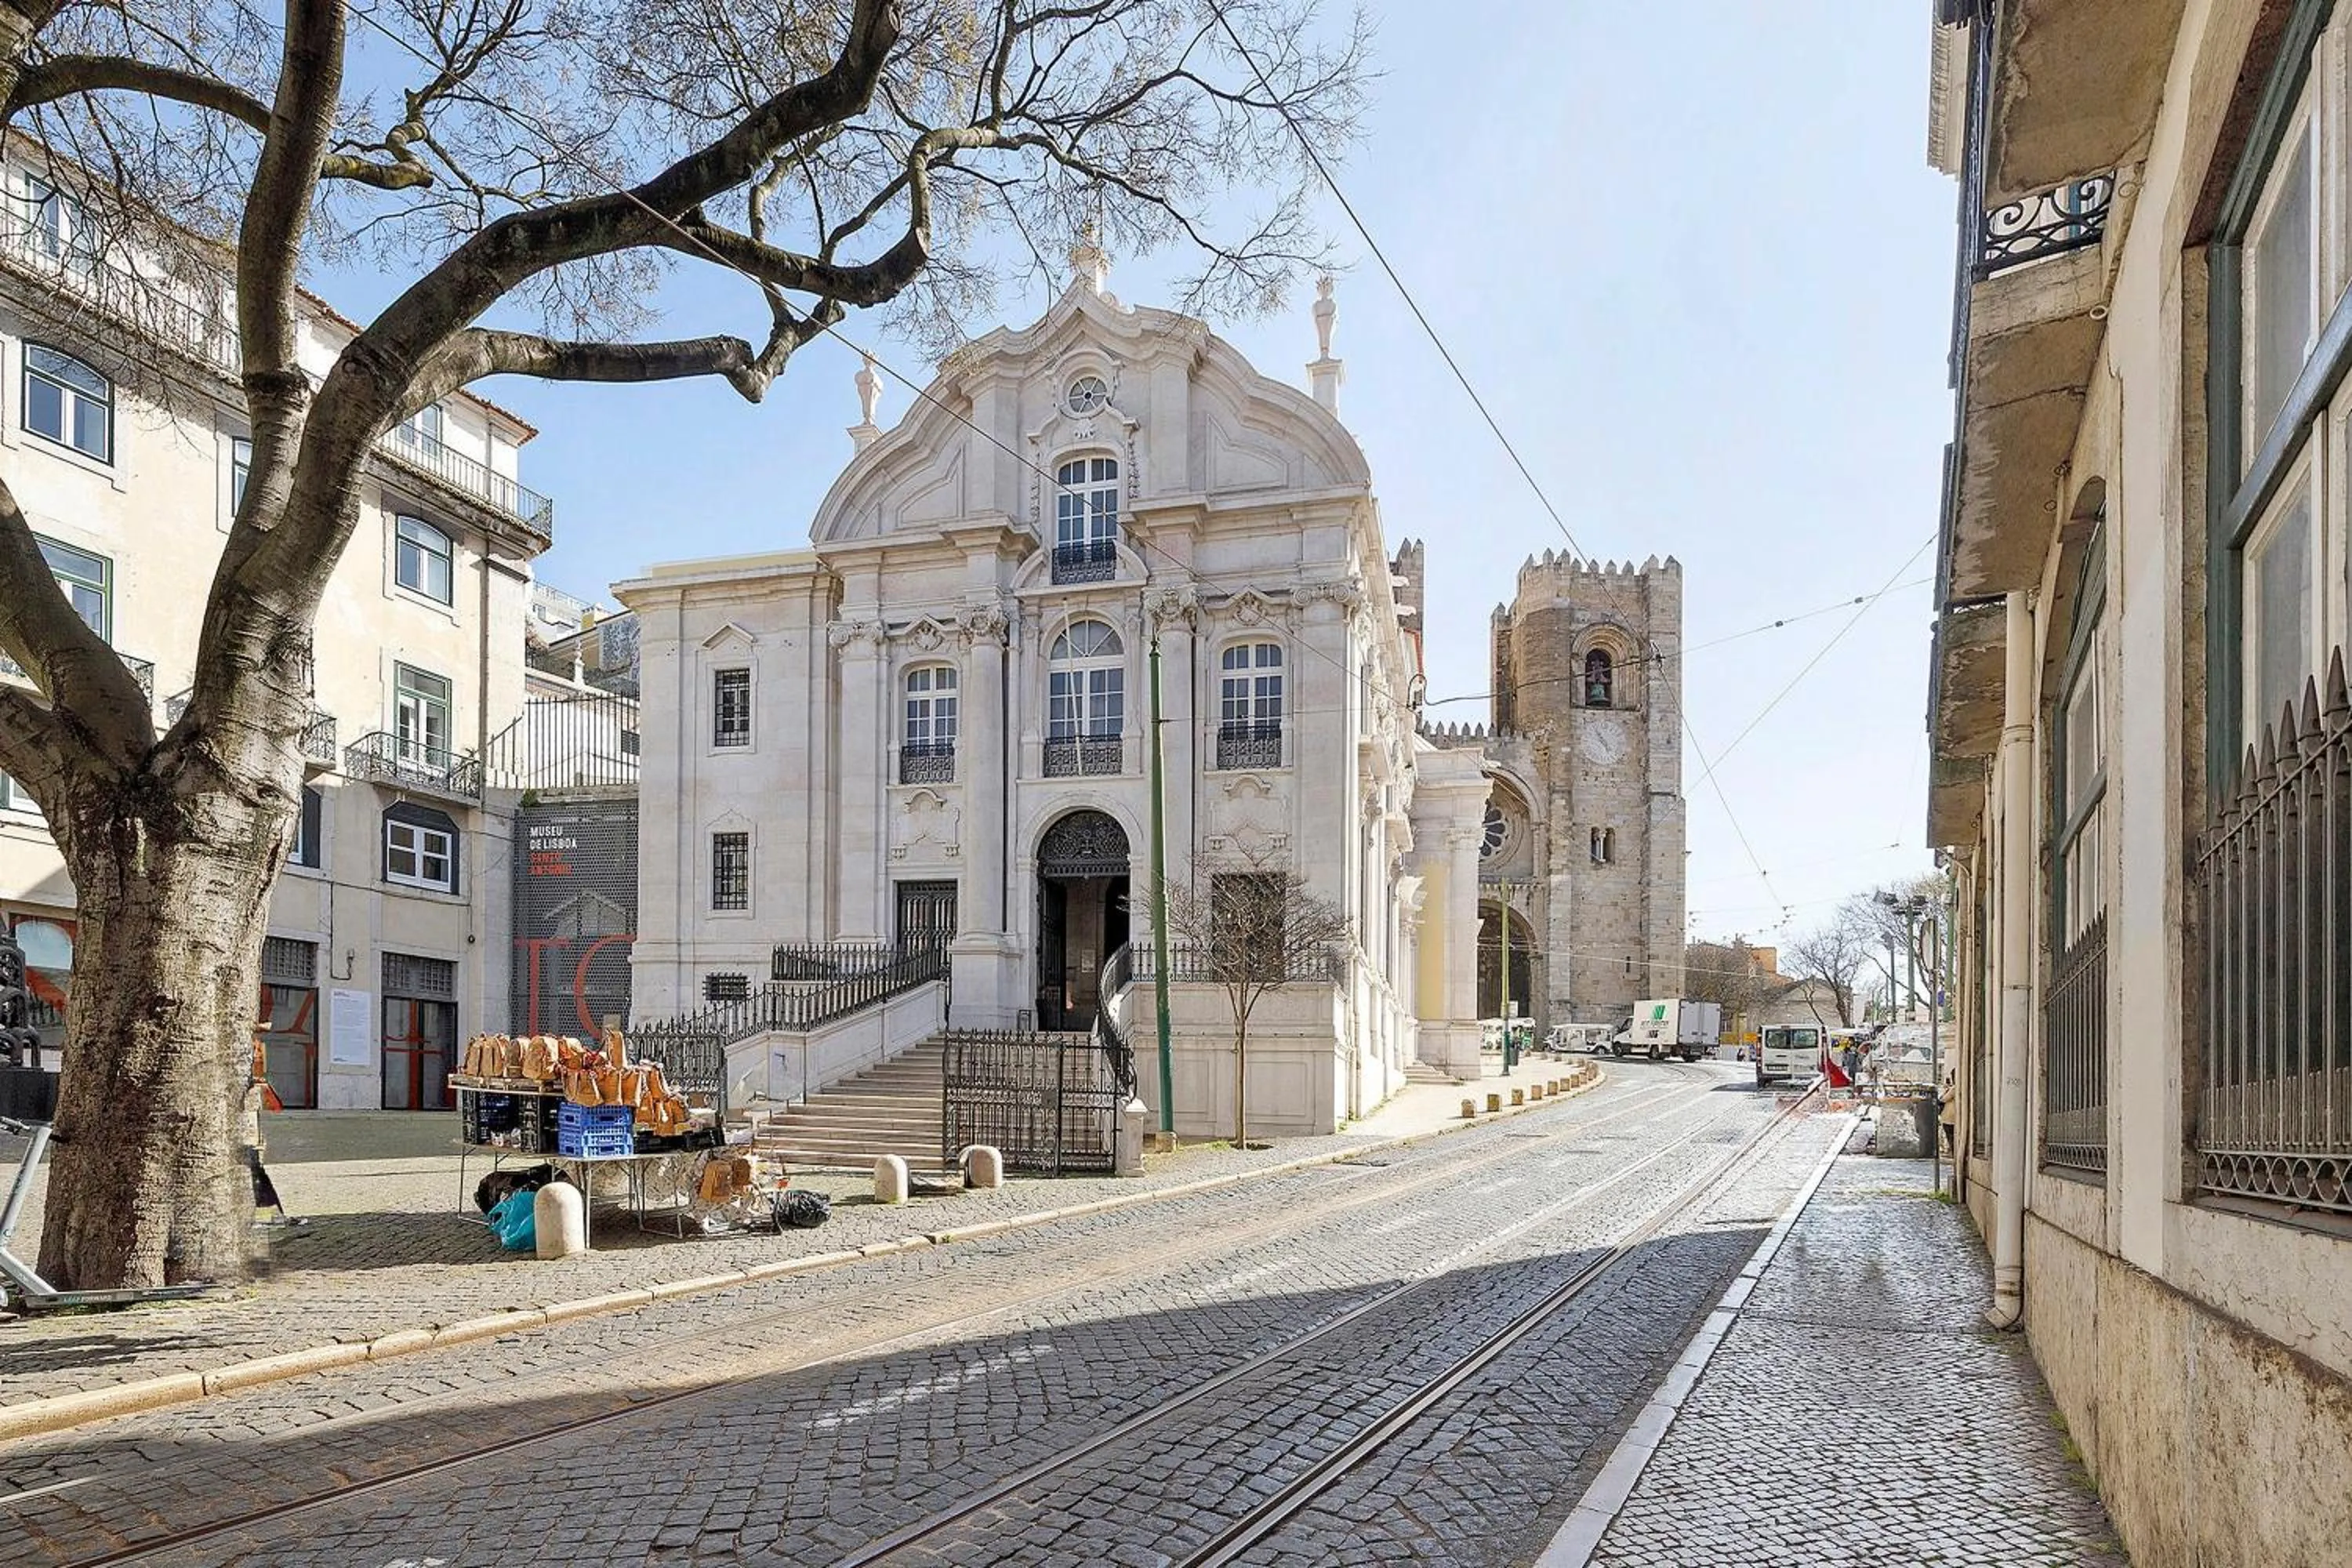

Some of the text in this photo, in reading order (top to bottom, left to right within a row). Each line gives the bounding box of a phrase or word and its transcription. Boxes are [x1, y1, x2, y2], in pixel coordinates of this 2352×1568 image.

[530, 826, 563, 837] MUSEU
[530, 838, 577, 851] DE LISBOA
